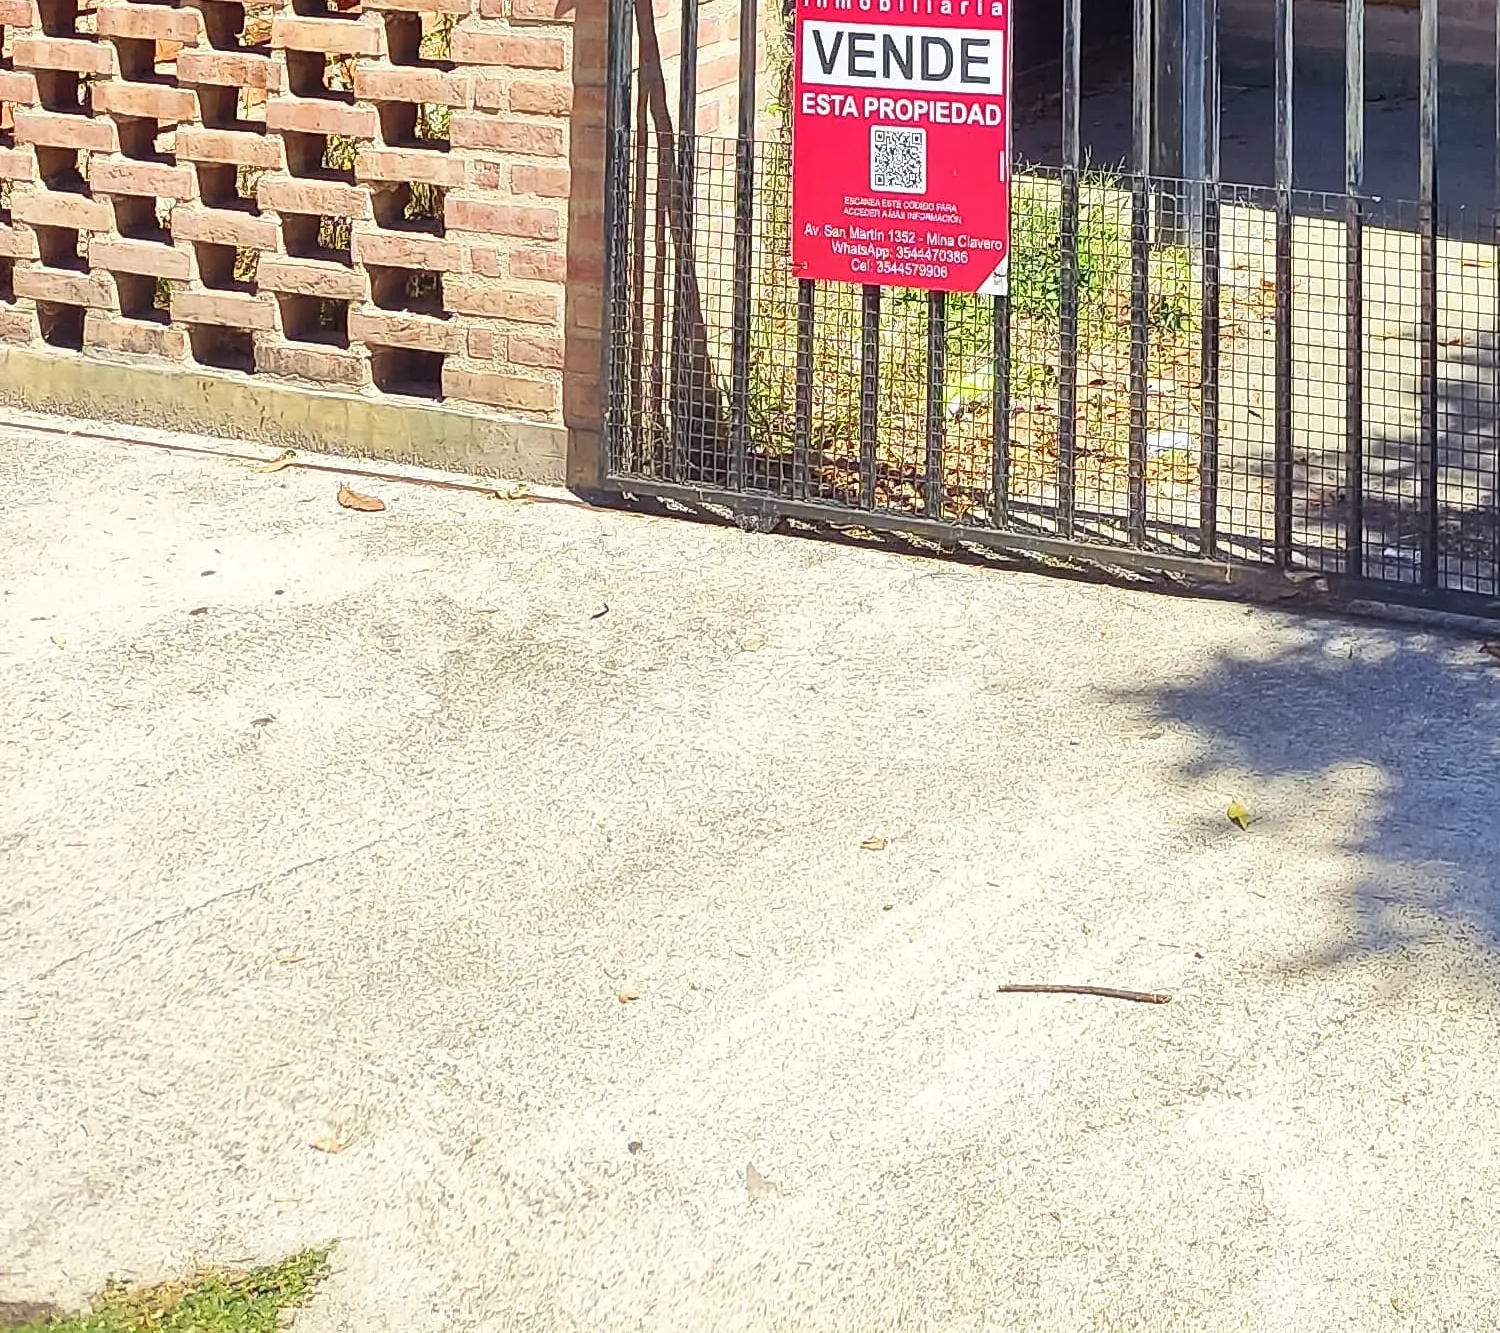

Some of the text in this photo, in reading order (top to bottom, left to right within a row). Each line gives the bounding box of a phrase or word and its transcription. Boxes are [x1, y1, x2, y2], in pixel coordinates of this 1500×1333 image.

[811, 29, 991, 84] VENDE
[802, 92, 1001, 126] ESTA PROPIEDAD
[824, 224, 847, 238] San
[888, 229, 916, 244] 1352
[926, 231, 955, 247] Mina
[957, 234, 1003, 251] Clavero
[831, 238, 969, 264] WhatsApp: 3544470386
[850, 258, 873, 272] Cel:
